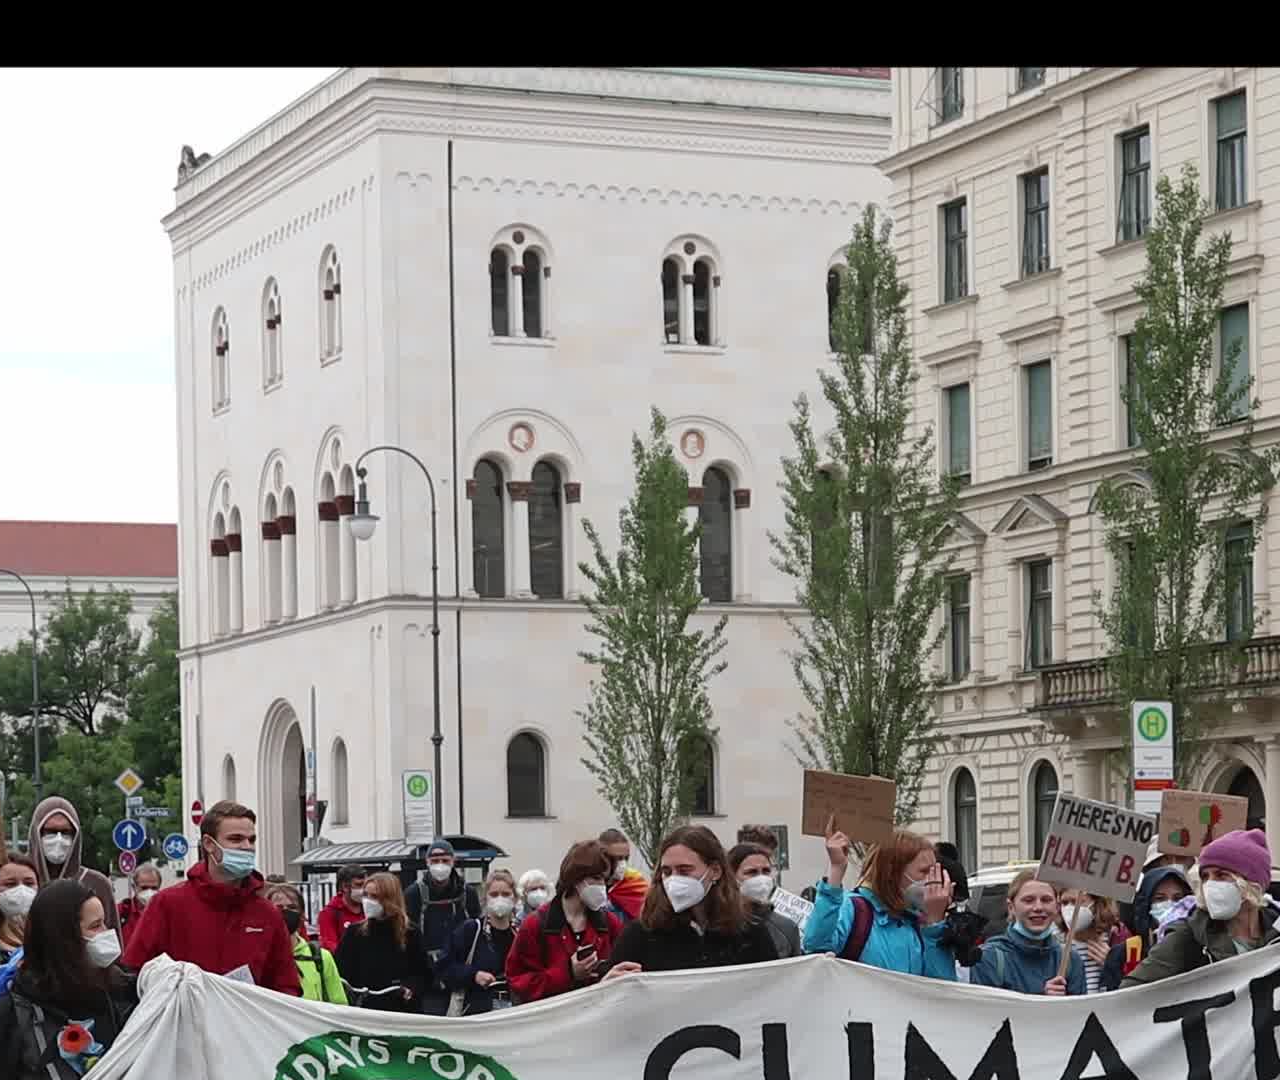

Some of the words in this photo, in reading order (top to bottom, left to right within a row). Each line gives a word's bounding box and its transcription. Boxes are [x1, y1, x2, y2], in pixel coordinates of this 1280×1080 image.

[1057, 798, 1125, 836] THERE'S
[1124, 816, 1154, 844] NO
[1042, 834, 1117, 878] PLANET
[1116, 854, 1136, 887] B.
